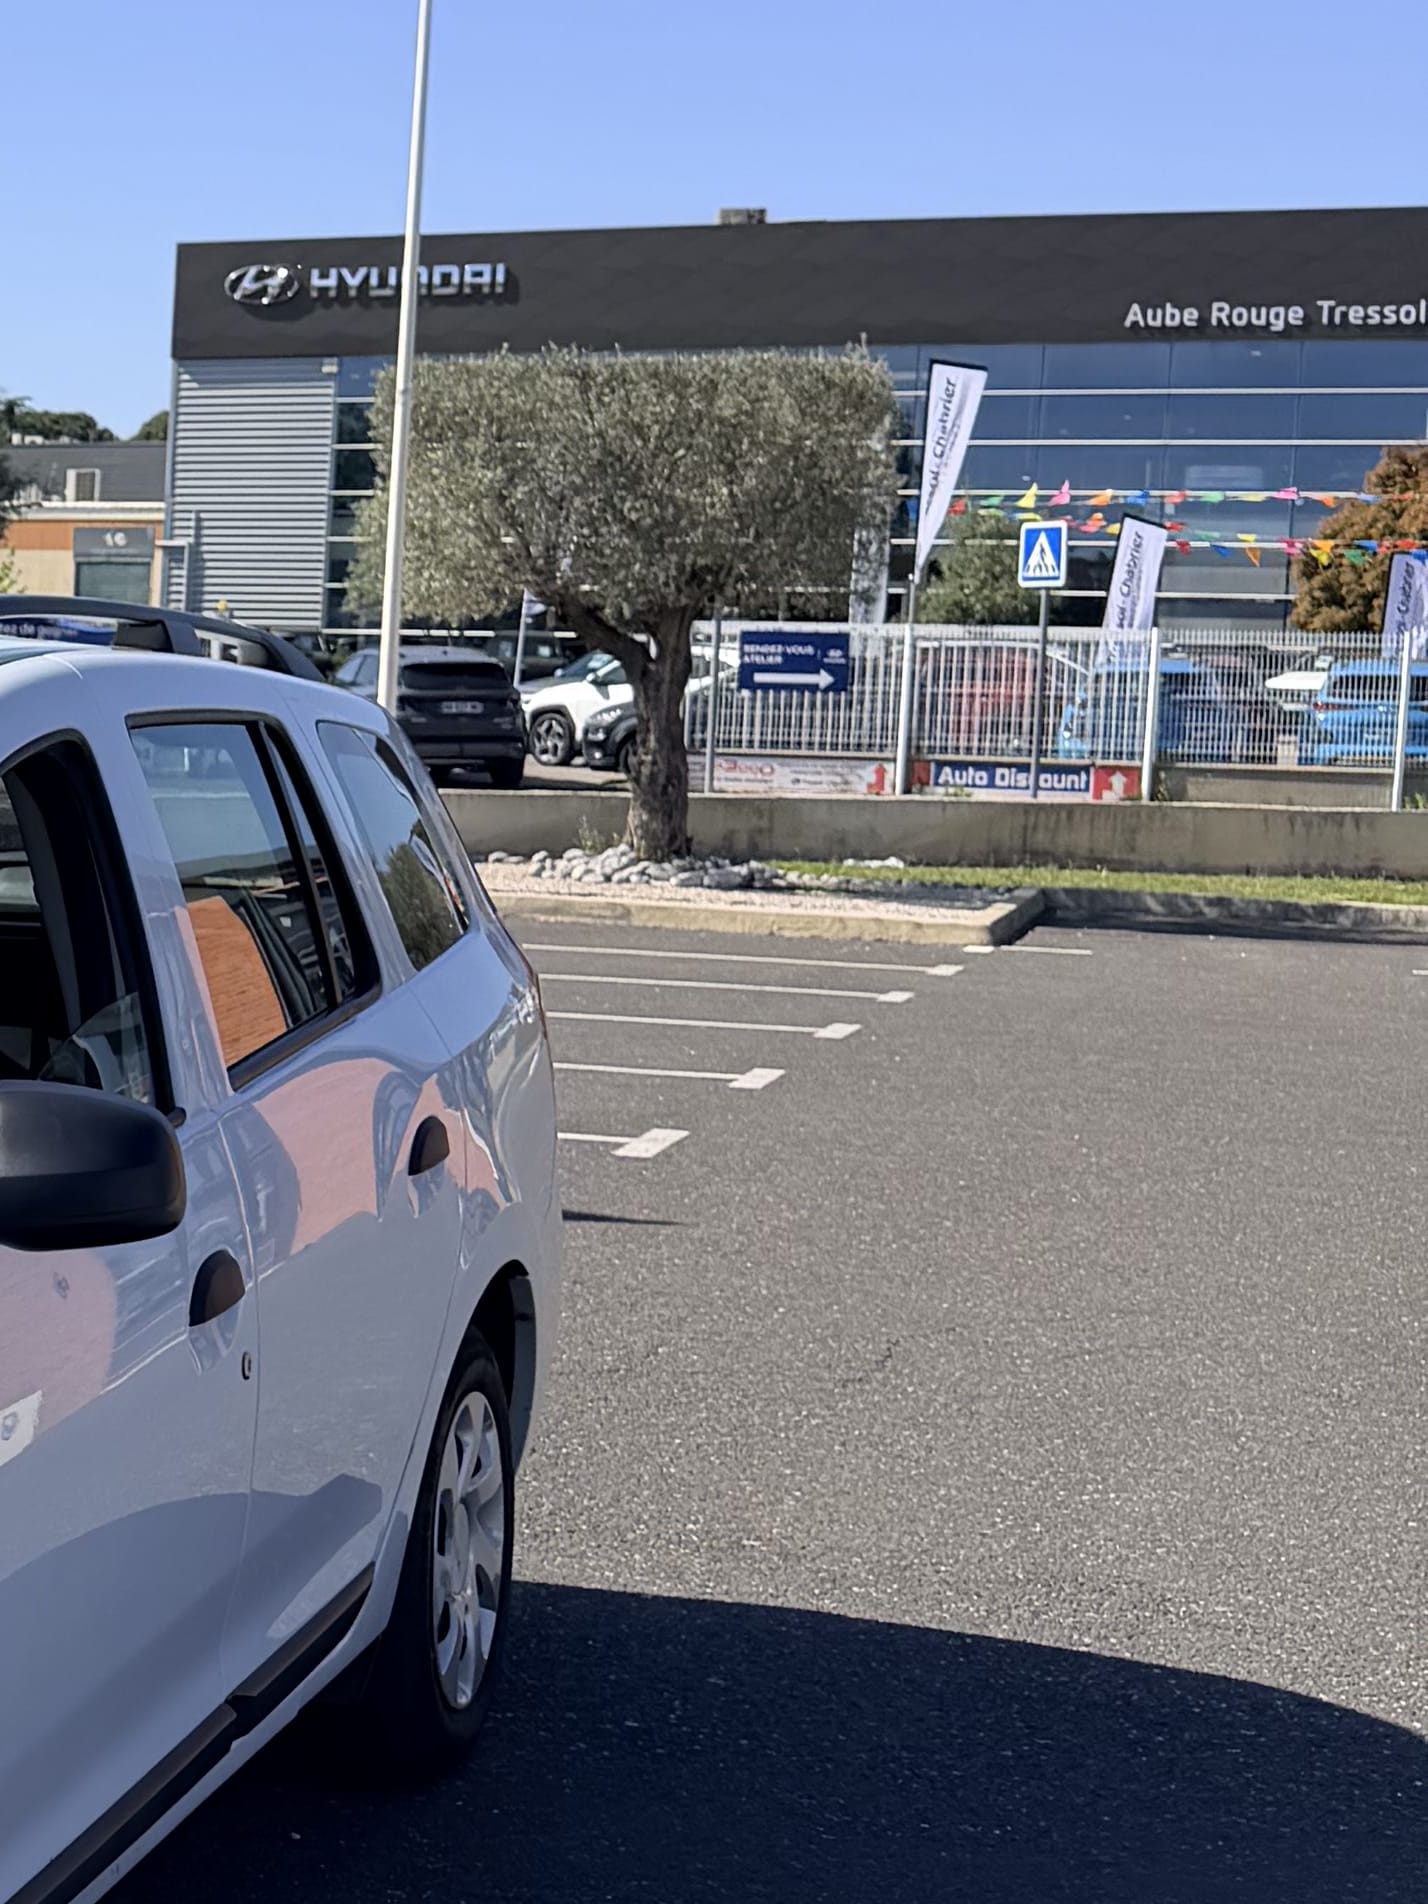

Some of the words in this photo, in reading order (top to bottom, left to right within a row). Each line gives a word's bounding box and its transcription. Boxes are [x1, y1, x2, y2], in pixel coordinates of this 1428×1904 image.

[1123, 302, 1199, 328] Aube
[1210, 301, 1304, 332] Rouge
[1316, 298, 1427, 326] Tressol
[938, 766, 988, 786] Auto
[995, 767, 1087, 790] Disount
